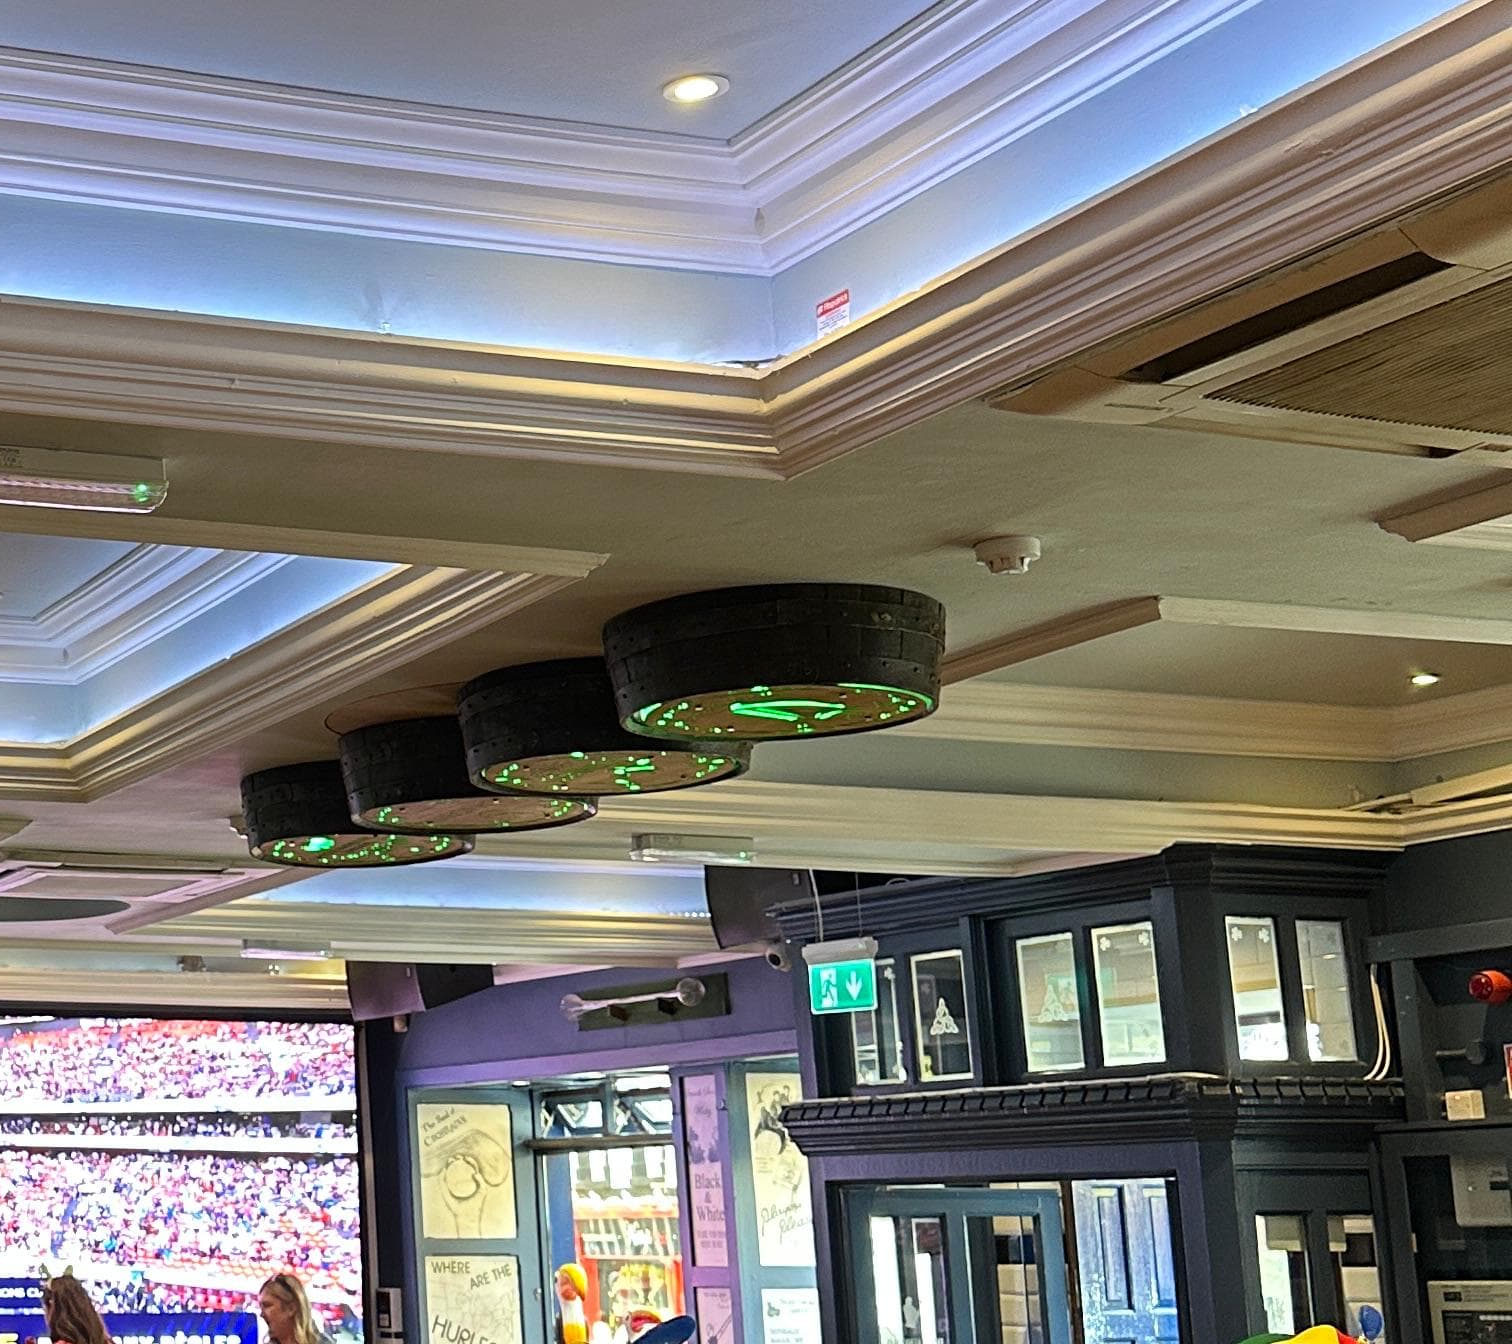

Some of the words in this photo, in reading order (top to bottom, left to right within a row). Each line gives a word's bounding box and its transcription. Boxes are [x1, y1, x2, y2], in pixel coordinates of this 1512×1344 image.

[694, 1173, 721, 1190] Black
[696, 1205, 725, 1222] White
[430, 1260, 471, 1275] WHERE
[469, 1275, 488, 1291] ARE
[490, 1263, 512, 1284] THE
